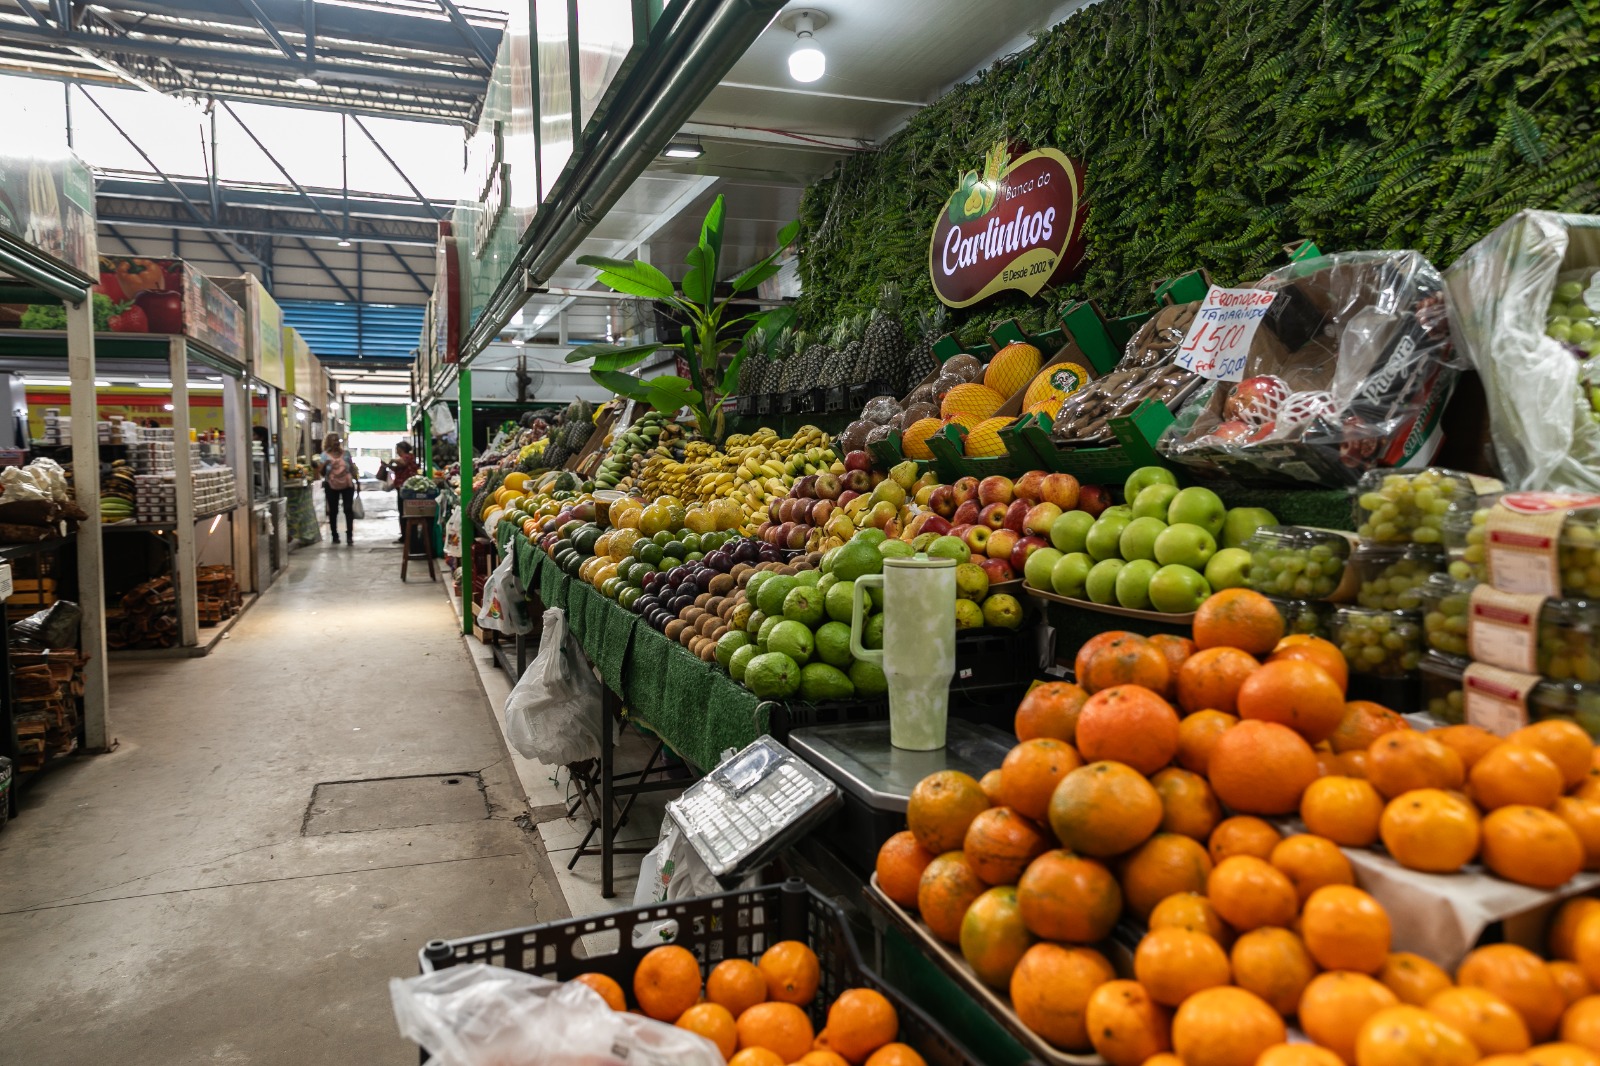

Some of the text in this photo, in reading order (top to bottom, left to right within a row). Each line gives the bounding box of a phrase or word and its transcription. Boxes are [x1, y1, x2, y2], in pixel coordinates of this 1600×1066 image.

[1005, 171, 1051, 201] Banca do
[942, 206, 1056, 276] Carlinhos
[1009, 260, 1047, 282] Desde 2002
[1180, 352, 1193, 368] 4
